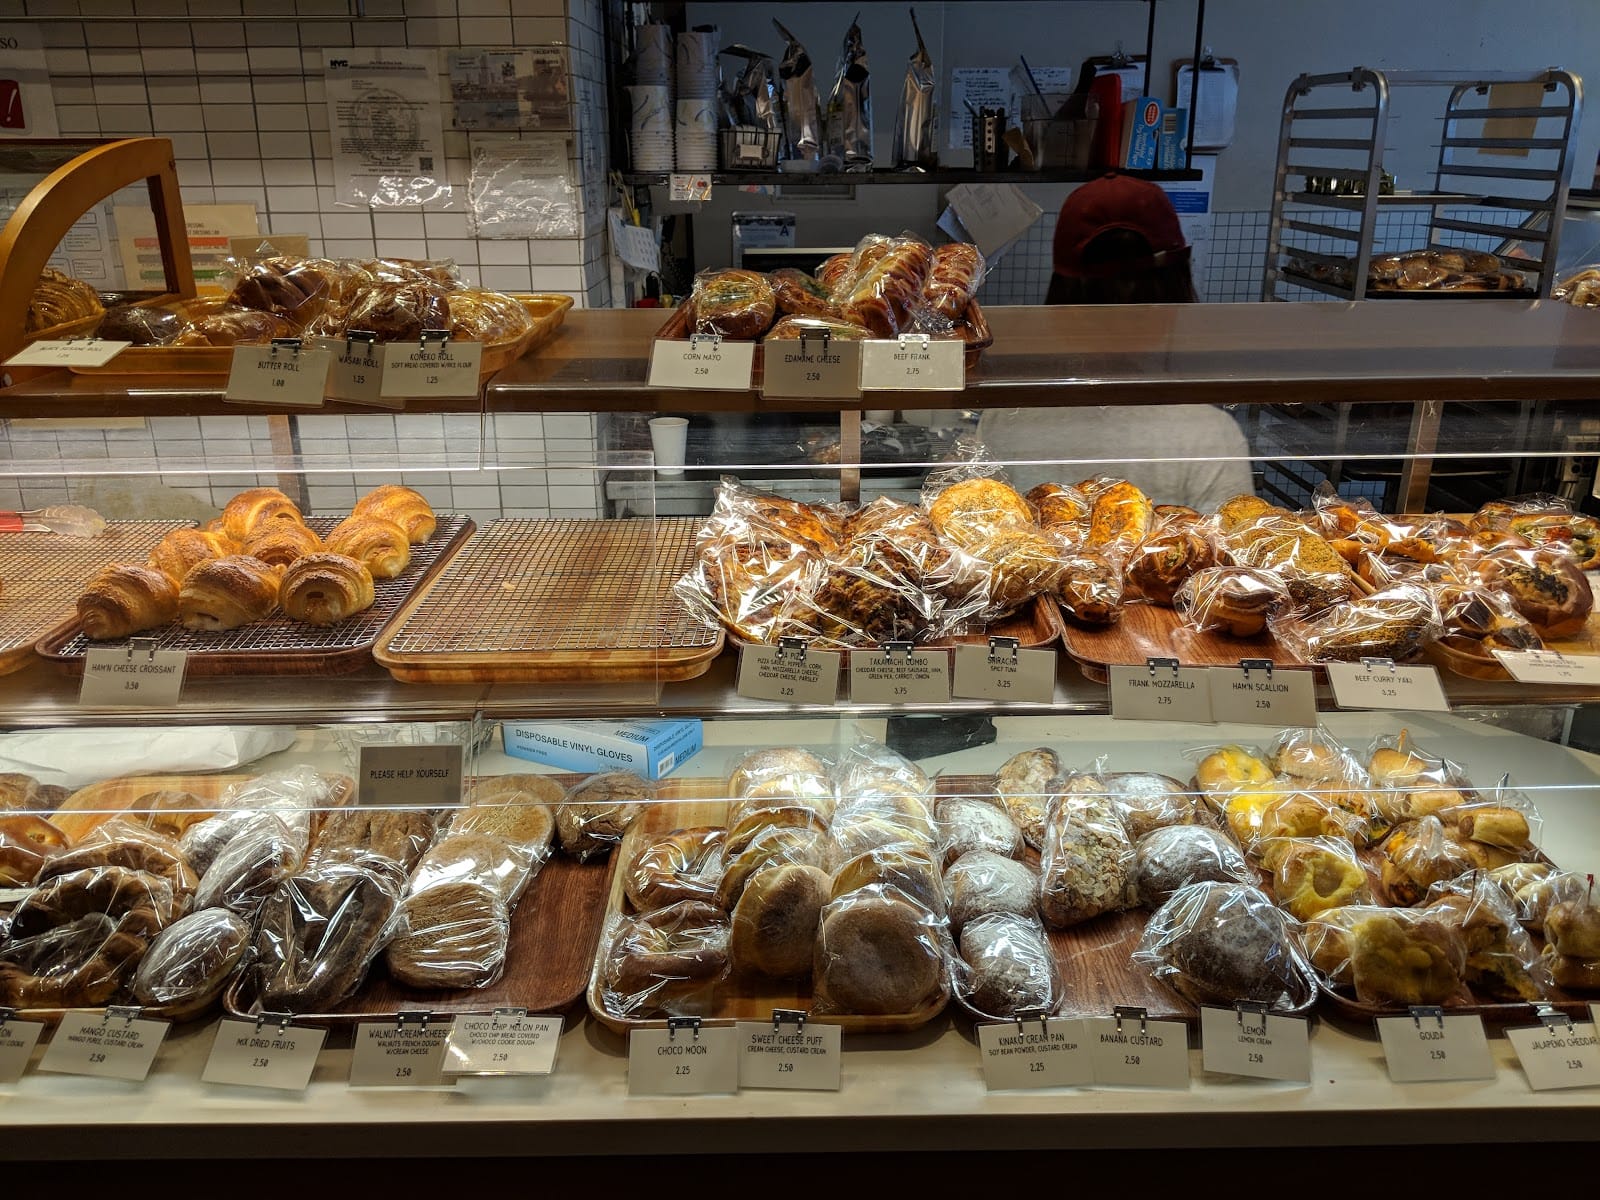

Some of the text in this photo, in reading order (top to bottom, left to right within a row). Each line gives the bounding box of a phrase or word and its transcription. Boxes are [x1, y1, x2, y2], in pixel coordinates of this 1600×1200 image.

[779, 225, 790, 237] A
[438, 352, 455, 361] ROLL
[683, 353, 722, 363] CORN MAYO
[784, 354, 841, 364] EDAMAME CHEESE
[893, 353, 932, 361] BEEF FRANK
[257, 360, 300, 373] BUTTER ROLL
[338, 355, 380, 369] WASABI ROLL
[391, 361, 404, 369] SOFT
[694, 367, 710, 375] 2.50
[906, 367, 920, 375] 2.75
[352, 375, 366, 384] 1.25
[426, 376, 439, 384] 1.25
[806, 372, 821, 382] 2.50
[272, 378, 286, 387] 1.00
[905, 658, 930, 667] COMBO
[988, 656, 1019, 666] SRIRACHA
[114, 663, 138, 673] CHEESE
[139, 663, 177, 674] CROISSANT
[990, 665, 1004, 673] SPICY
[758, 671, 779, 680] CHEDDAR
[1355, 674, 1371, 682] BEEF
[1372, 675, 1395, 684] CURRY
[124, 681, 140, 691] 3.50
[997, 680, 1012, 688] 3.25
[1128, 679, 1196, 691] FRANK MOZZARELLA
[1232, 682, 1290, 693] HAM'N SCALLION
[780, 687, 795, 696] 3.25
[893, 686, 909, 696] 3.75
[1157, 696, 1172, 705] 2.75
[1255, 700, 1271, 710] 2.50
[614, 730, 650, 743] MEDIUM
[515, 728, 634, 763] DISPOSABLE VINYL GLOVES
[675, 742, 697, 765] MEDIUM
[370, 768, 450, 779] PLEASE HELP YOURSELF
[464, 1021, 550, 1032] CHOCO CHIP MELON PAN
[1242, 1025, 1266, 1036] LEMON
[80, 1026, 141, 1041] MANGO CUSTARD
[369, 1029, 398, 1039] WALNUT
[399, 1029, 424, 1039] CREAM
[469, 1031, 488, 1039] CHOCO
[488, 1031, 500, 1039] CHIP
[517, 1032, 541, 1040] COVERED
[1419, 1031, 1446, 1041] GOUDA
[67, 1035, 87, 1043] MANGO
[103, 1038, 127, 1048] CUSTARD
[127, 1041, 145, 1049] CREAM
[235, 1037, 297, 1051] MIX DRIED FRUITS
[377, 1039, 441, 1048] WALNUTS FRENCH DOUGH
[498, 1038, 516, 1046] COOKIE
[751, 1034, 824, 1047] SWEET CHEESE PUFF
[998, 1033, 1065, 1047] KINAKO CREAM PAN
[1100, 1034, 1164, 1047] BANANA CUSTARD
[1238, 1035, 1273, 1046] LEMON CREAM
[386, 1047, 430, 1056] W/CREAM CHEESE
[656, 1045, 708, 1057] CHOCO MOON
[747, 1045, 764, 1053] CREAM
[786, 1046, 810, 1055] CUSTARD
[810, 1047, 828, 1055] CREAM
[988, 1048, 1000, 1057] SOY
[1000, 1047, 1014, 1056] BEAN
[1037, 1044, 1061, 1054] CUSTARD
[1061, 1042, 1078, 1051] CREAM
[89, 1052, 106, 1063] 2.50
[493, 1053, 509, 1062] 2.50
[1125, 1055, 1141, 1065] 2.50
[1248, 1053, 1264, 1063] 2.50
[1430, 1050, 1447, 1060] 2.50
[253, 1058, 270, 1068] 2.50
[778, 1063, 795, 1073] 2.50
[1029, 1062, 1046, 1073] 2.25
[1566, 1059, 1584, 1069] 2.50
[395, 1067, 412, 1078] 2.50
[675, 1065, 692, 1076] 2.25
